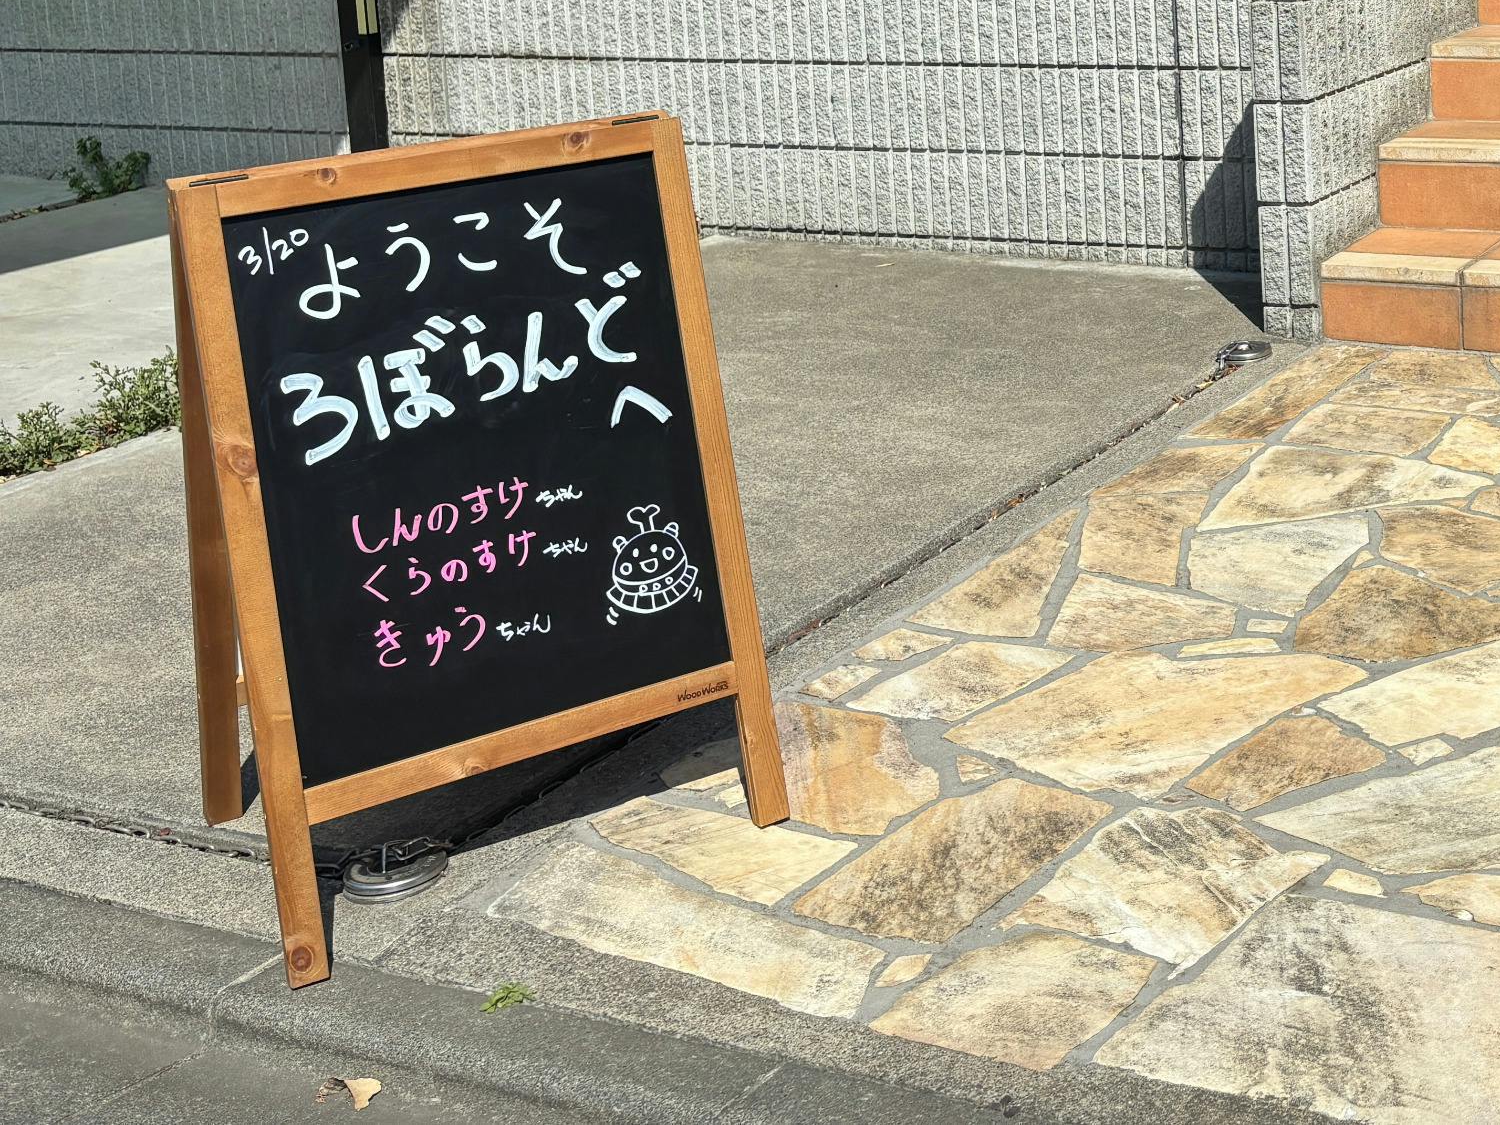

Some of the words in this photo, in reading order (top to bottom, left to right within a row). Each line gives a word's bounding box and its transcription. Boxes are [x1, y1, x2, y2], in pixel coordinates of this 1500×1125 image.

[238, 226, 309, 276] 3/20
[299, 197, 588, 320] ようこそ
[280, 261, 642, 466] ろぼらんど
